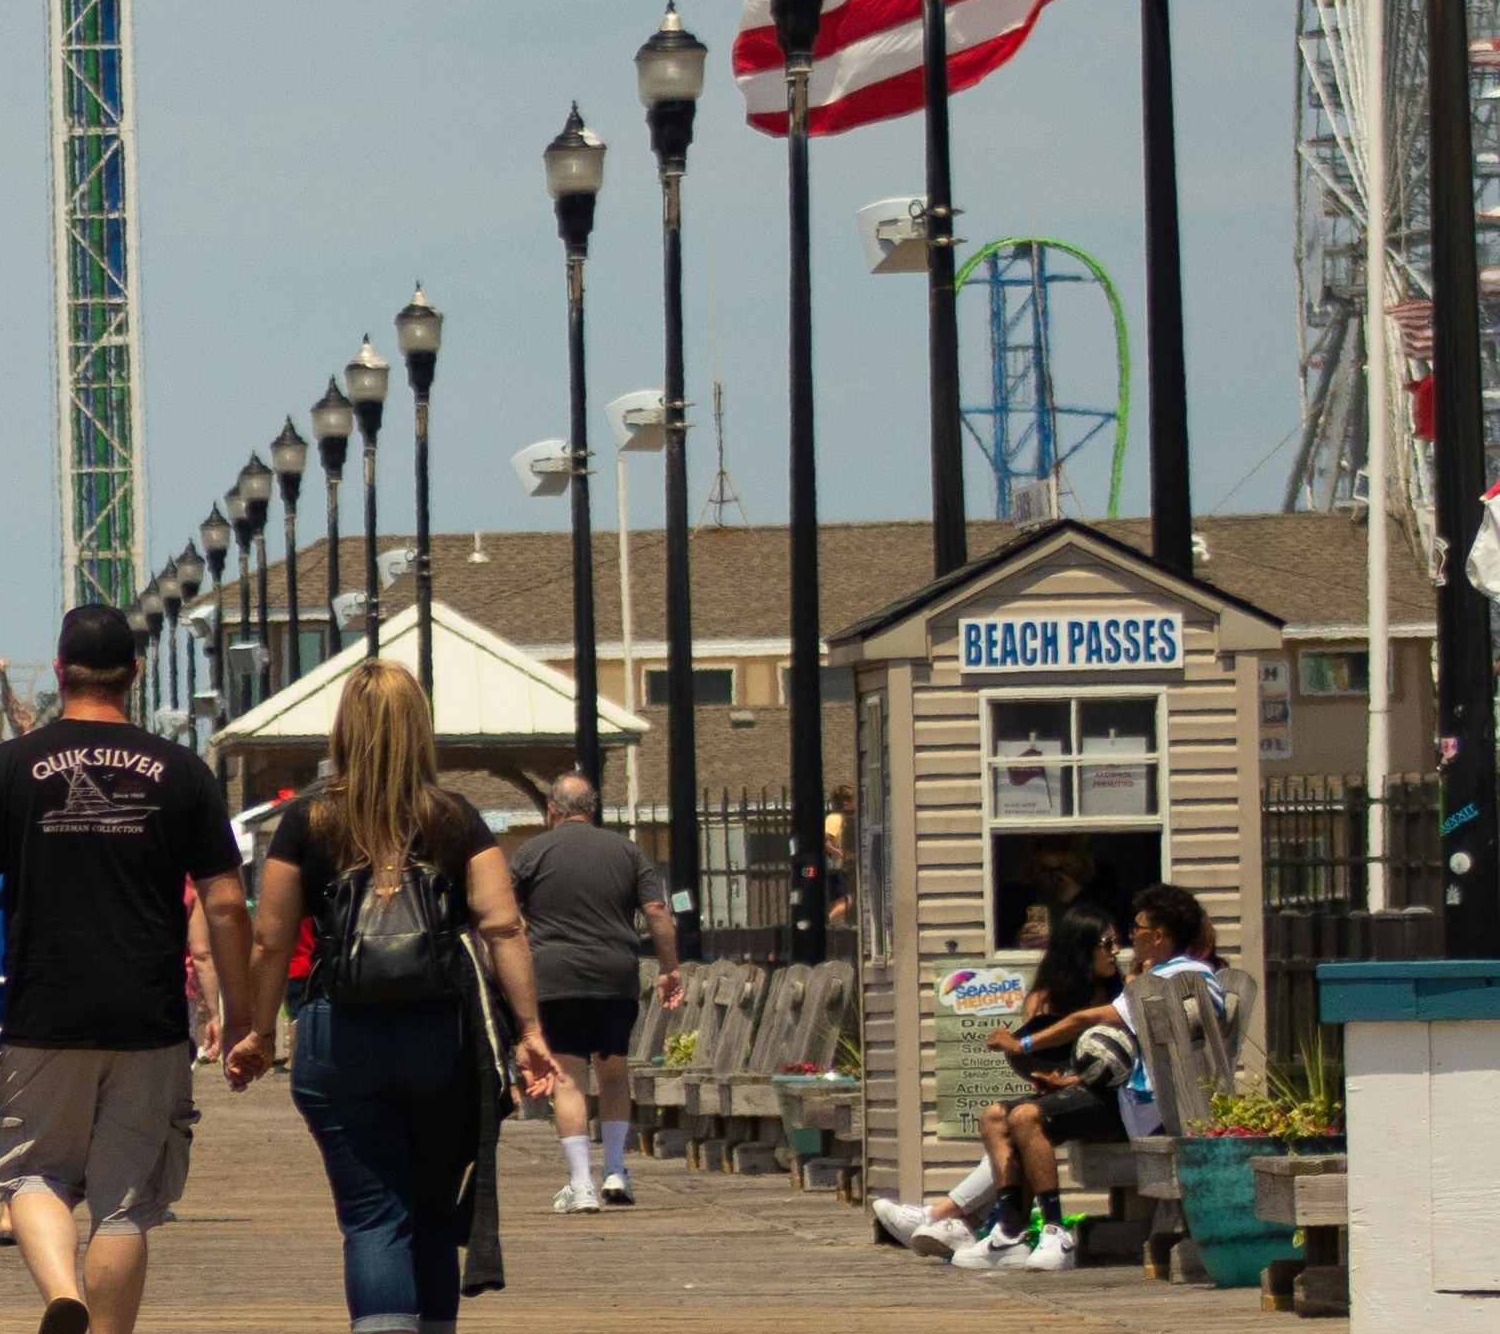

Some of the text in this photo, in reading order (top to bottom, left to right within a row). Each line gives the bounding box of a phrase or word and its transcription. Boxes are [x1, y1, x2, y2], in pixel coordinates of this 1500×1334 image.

[964, 619, 1178, 668] BEACH PASSES
[32, 747, 165, 783] QUIKSILVER
[42, 824, 143, 834] WATERMAN COLLECTION
[961, 1019, 1013, 1029] Daily
[962, 1070, 990, 1079] Senior
[956, 1083, 1000, 1094] Active
